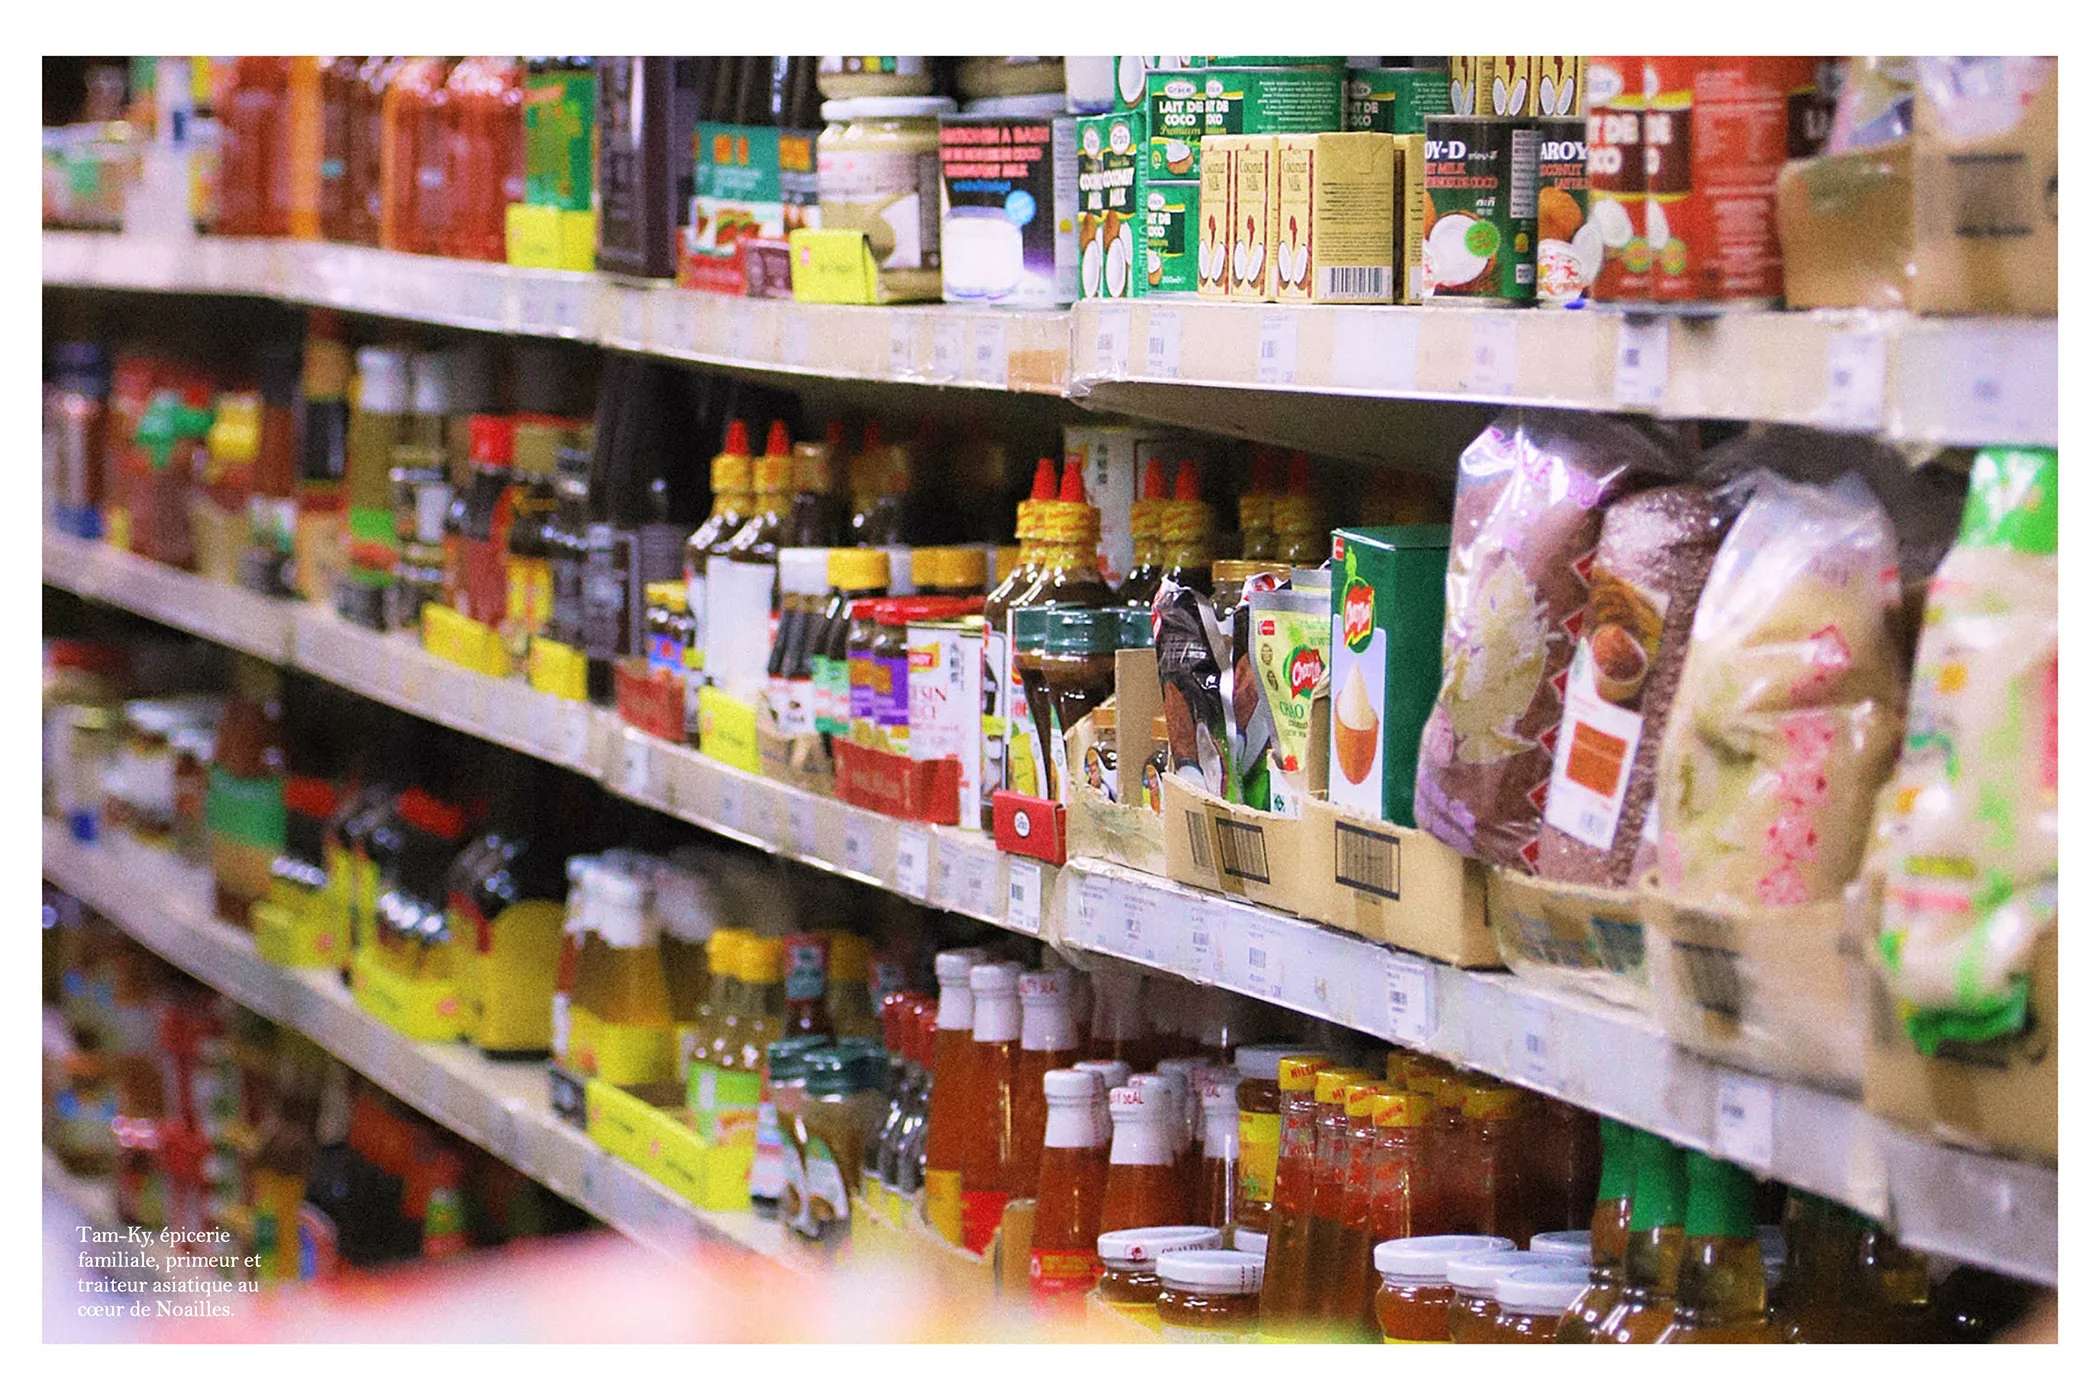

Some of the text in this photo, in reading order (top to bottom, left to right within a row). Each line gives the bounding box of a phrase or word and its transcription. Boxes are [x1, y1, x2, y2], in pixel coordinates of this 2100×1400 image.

[1159, 101, 1204, 113] LAIT DE
[1165, 114, 1196, 126] COCO
[1605, 114, 1638, 143] DE
